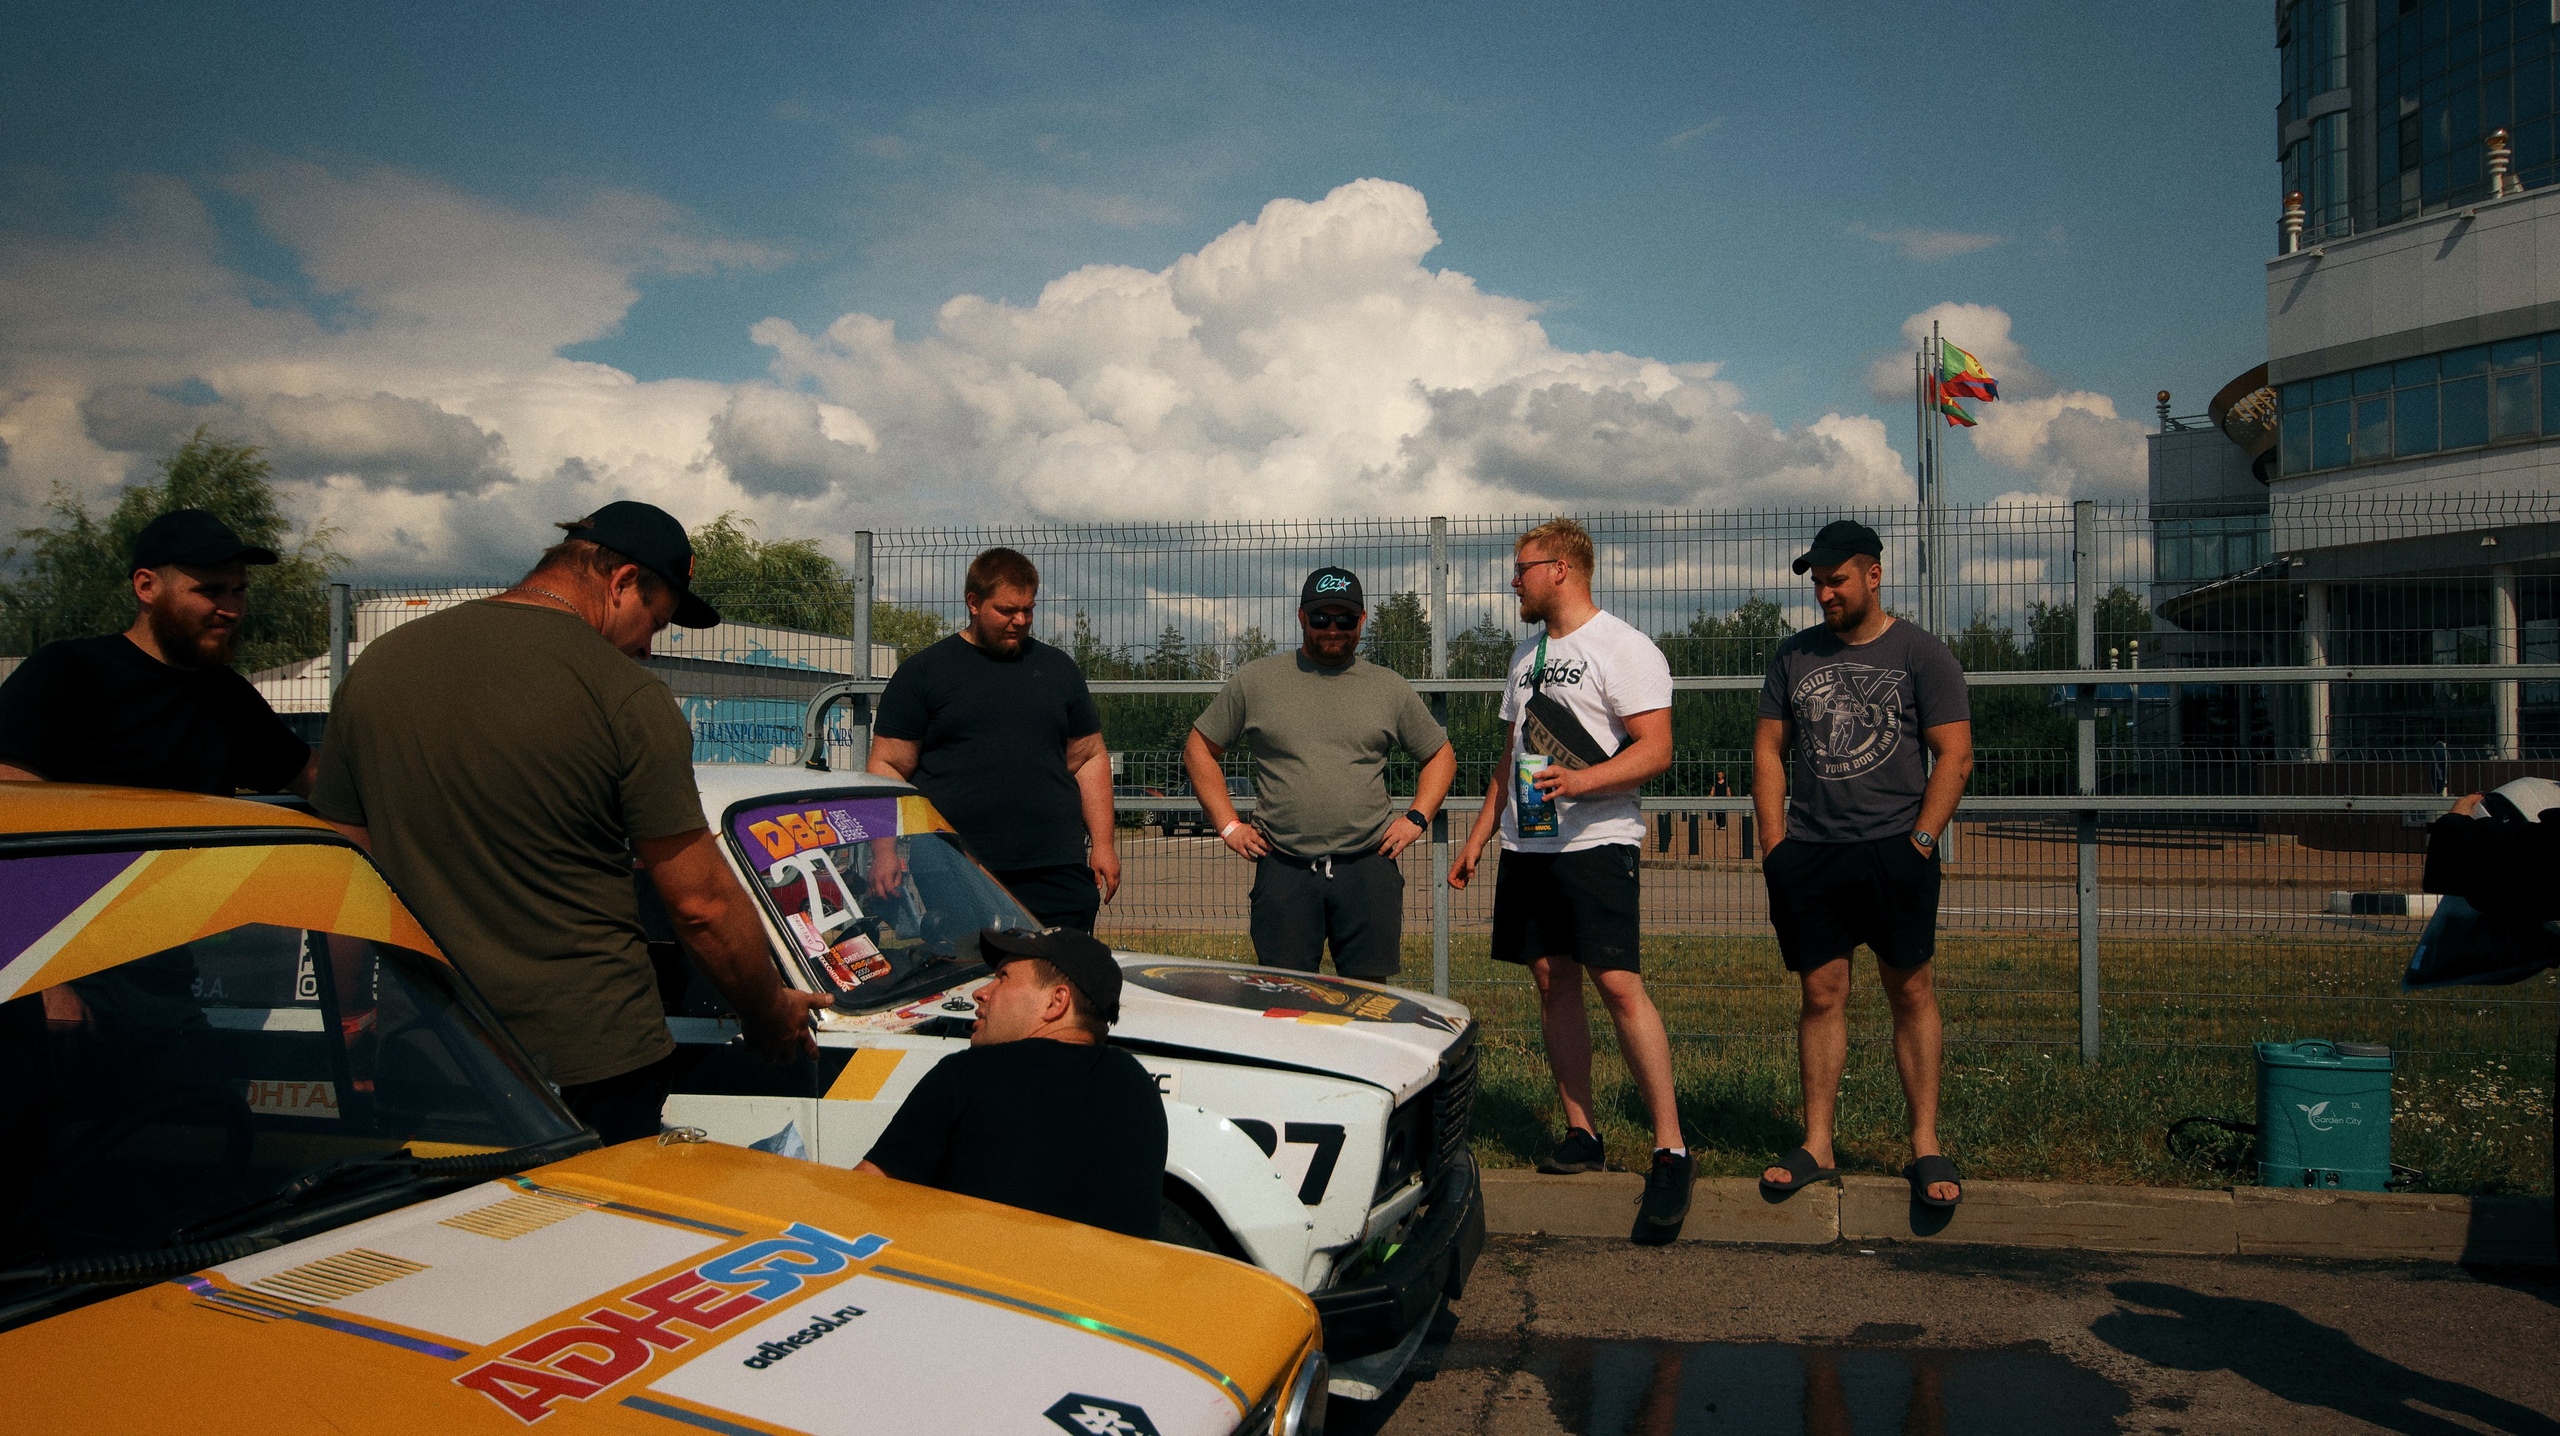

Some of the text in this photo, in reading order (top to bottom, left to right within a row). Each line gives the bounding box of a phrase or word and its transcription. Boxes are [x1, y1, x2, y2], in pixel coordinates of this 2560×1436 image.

[1794, 670, 1835, 705] INSIDE
[1825, 705, 1897, 774] YOUR BODY AND MIND
[818, 954, 851, 993] ЕХКОНТРОЛЬ
[2313, 1116, 2362, 1126] Garden City
[451, 1222, 894, 1426] ADHESOL
[743, 1304, 867, 1370] adhesol.ru
